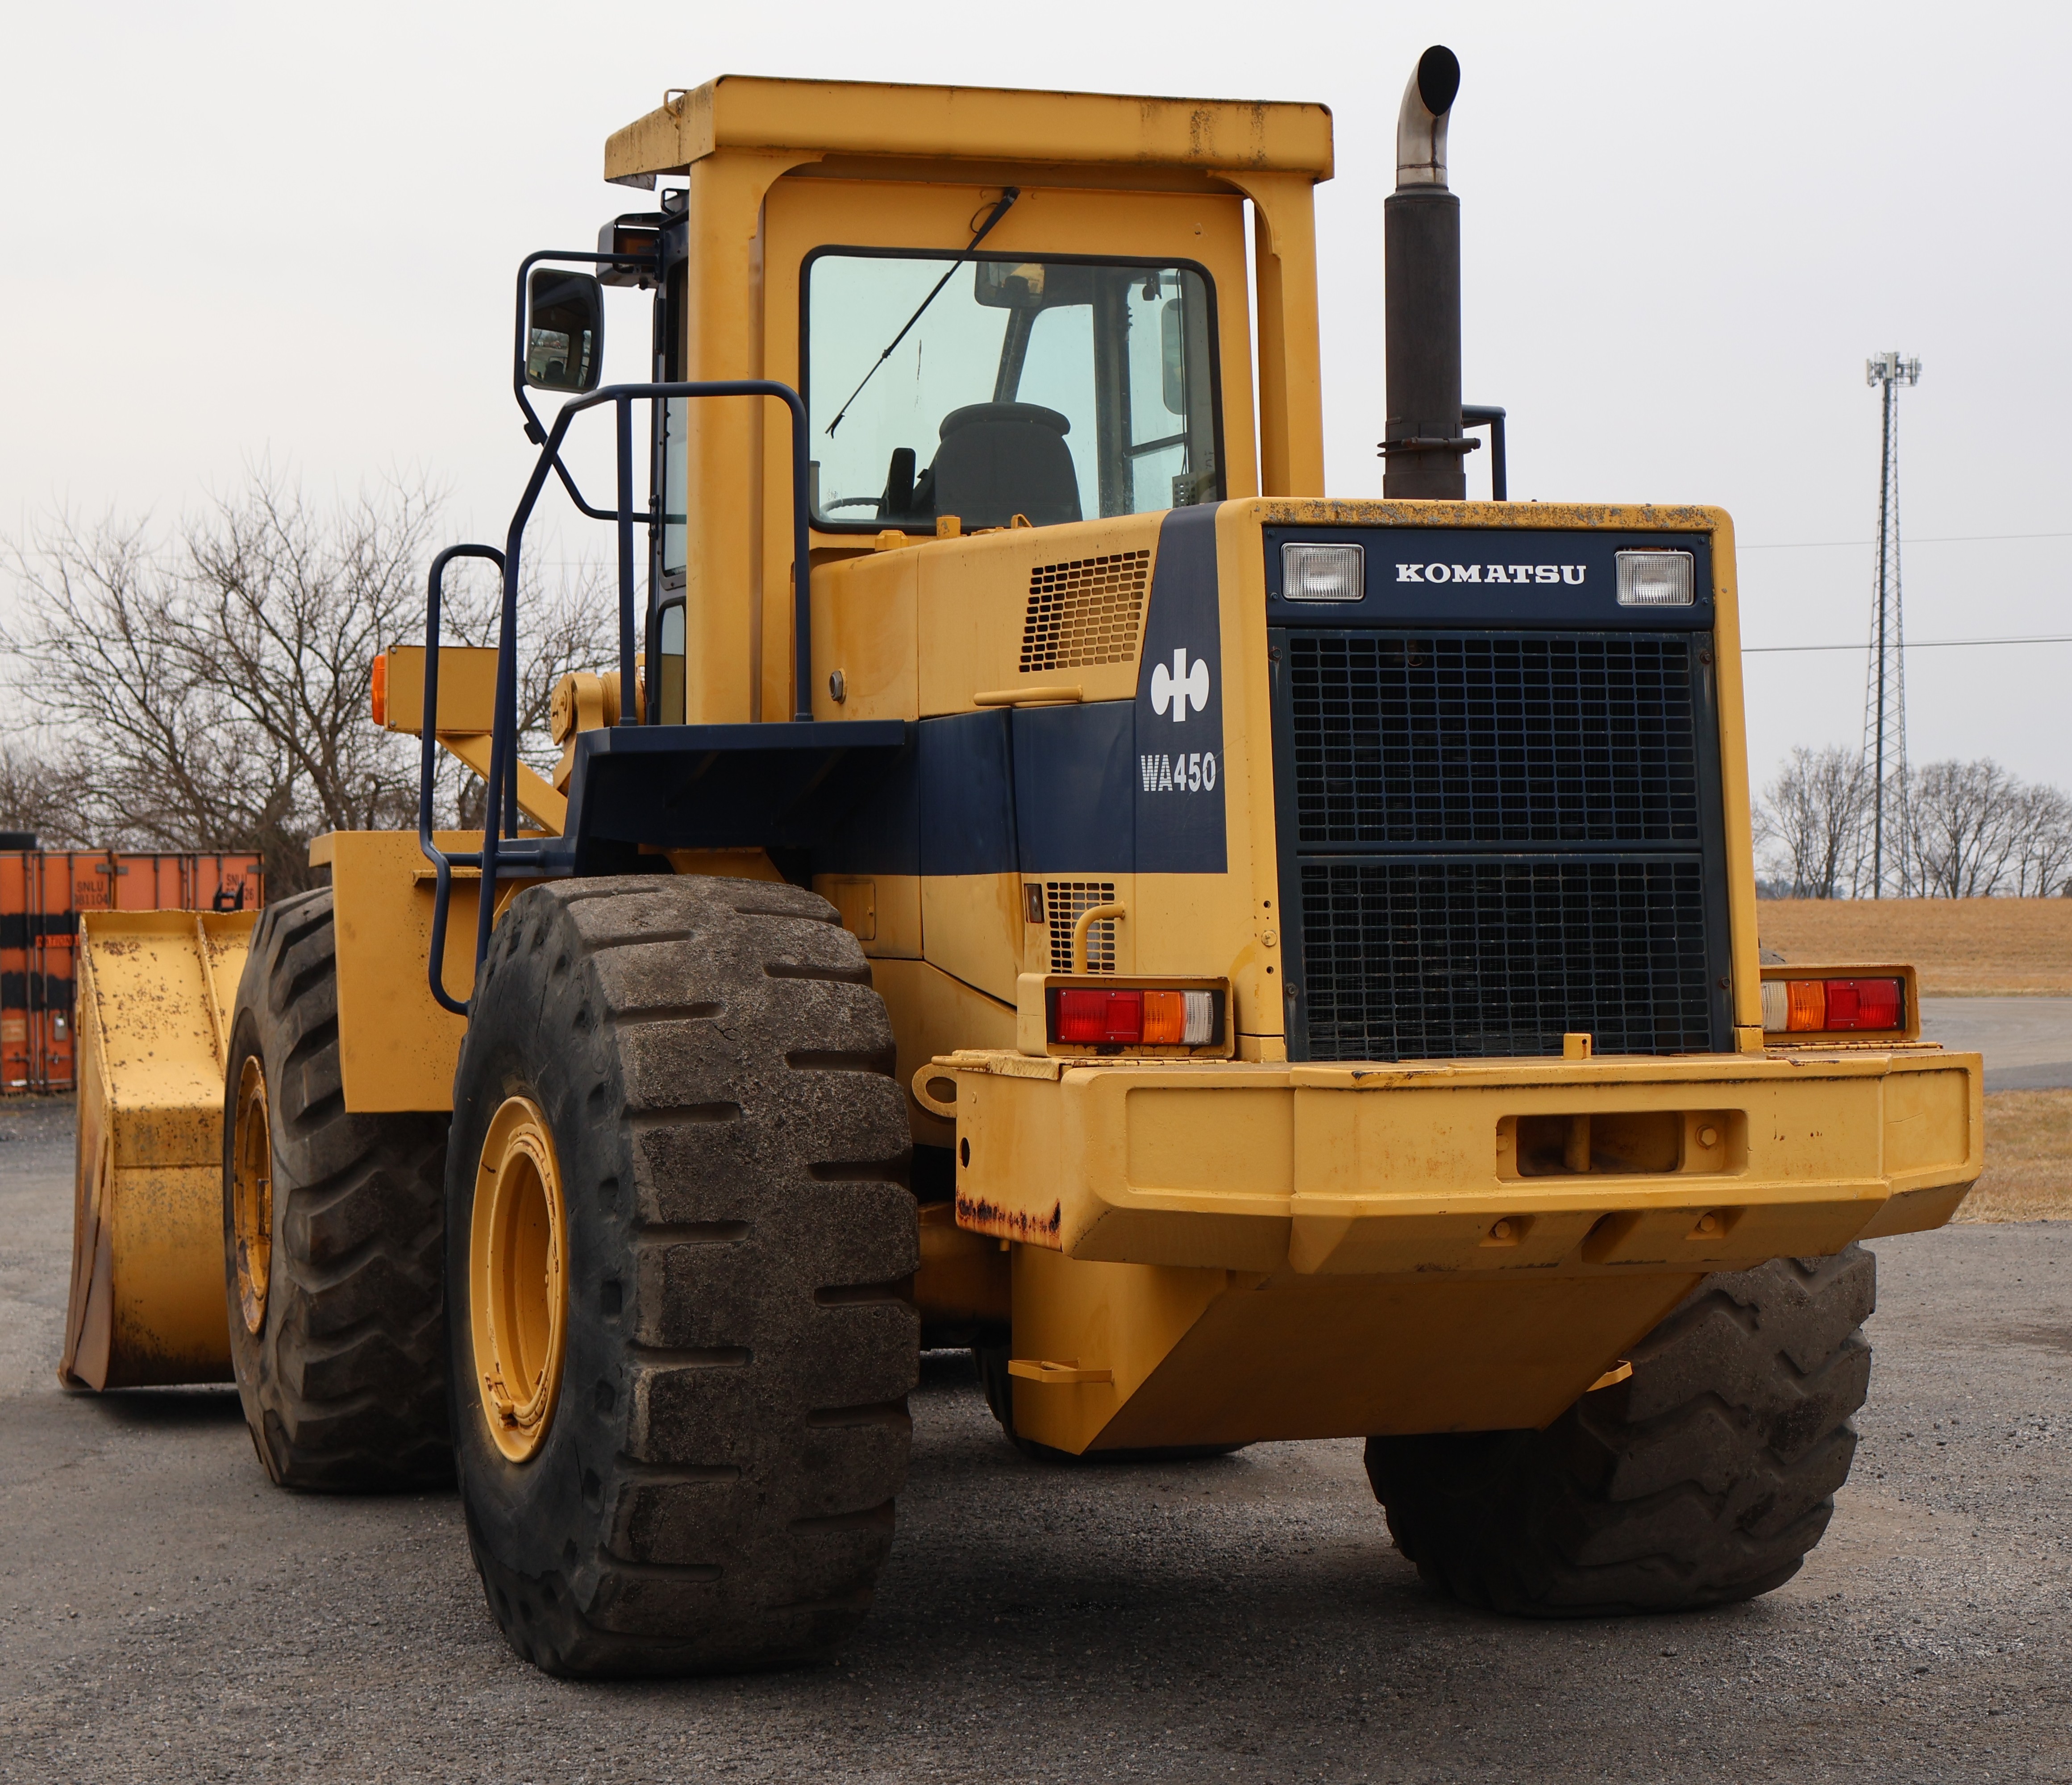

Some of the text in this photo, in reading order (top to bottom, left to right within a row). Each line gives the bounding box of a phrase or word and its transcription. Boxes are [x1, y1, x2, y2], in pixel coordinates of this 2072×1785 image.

[1395, 563, 1586, 585] KOMATSU
[1140, 751, 1216, 792] WA450
[77, 880, 104, 892] SNLU
